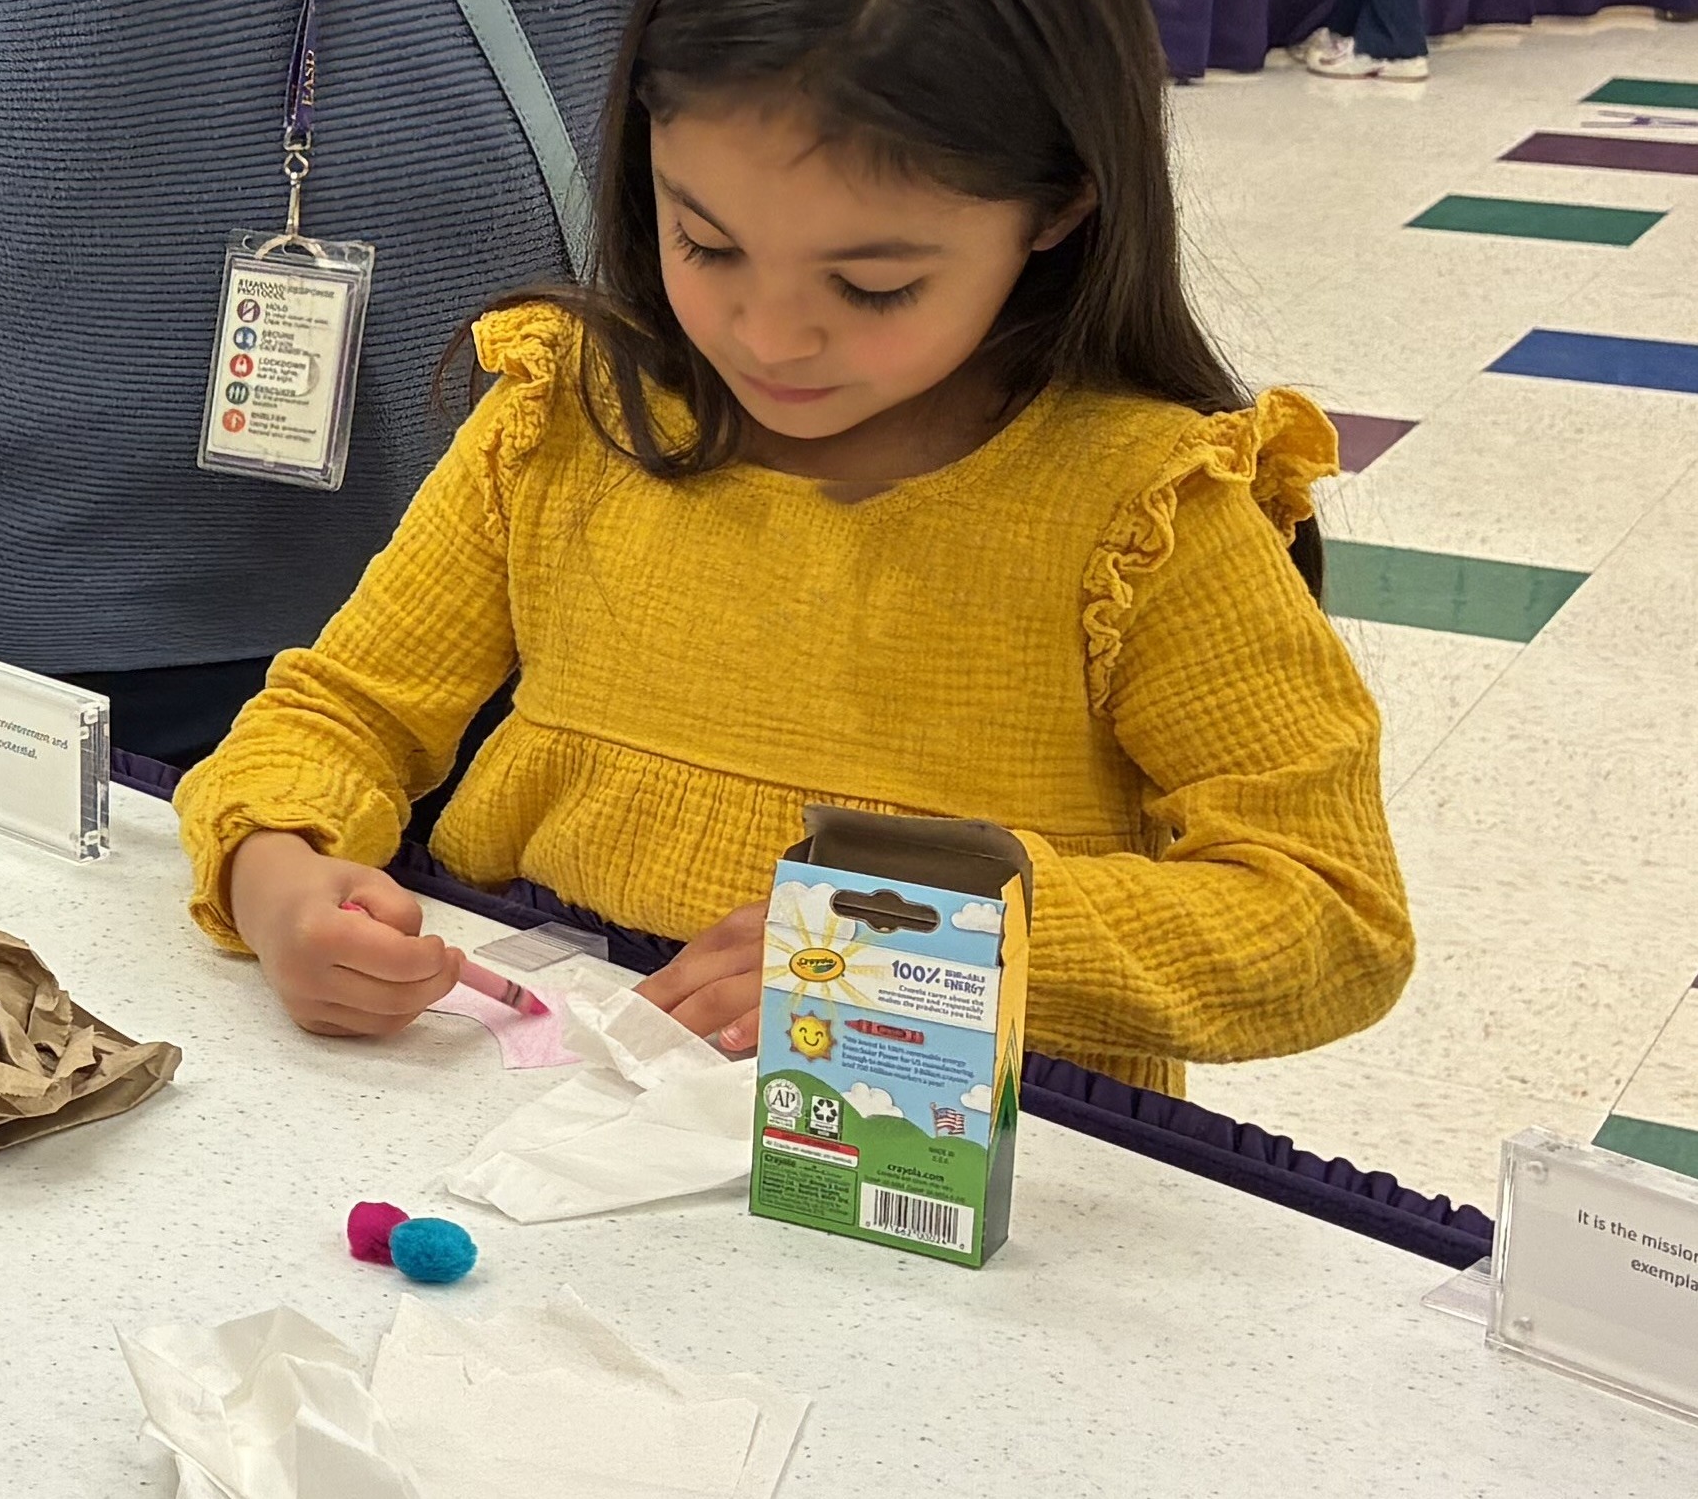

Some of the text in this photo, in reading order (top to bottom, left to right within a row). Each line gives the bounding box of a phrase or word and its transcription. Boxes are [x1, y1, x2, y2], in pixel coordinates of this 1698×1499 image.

[259, 357, 306, 370] LOCKDOWN
[52, 735, 69, 750] and
[892, 960, 941, 983] 100%
[944, 979, 985, 996] ENERGY
[771, 1089, 796, 1108] AP
[887, 1163, 945, 1182] crayola.com
[1578, 1208, 1590, 1226] It
[1593, 1214, 1607, 1231] is
[1610, 1221, 1638, 1242] the
